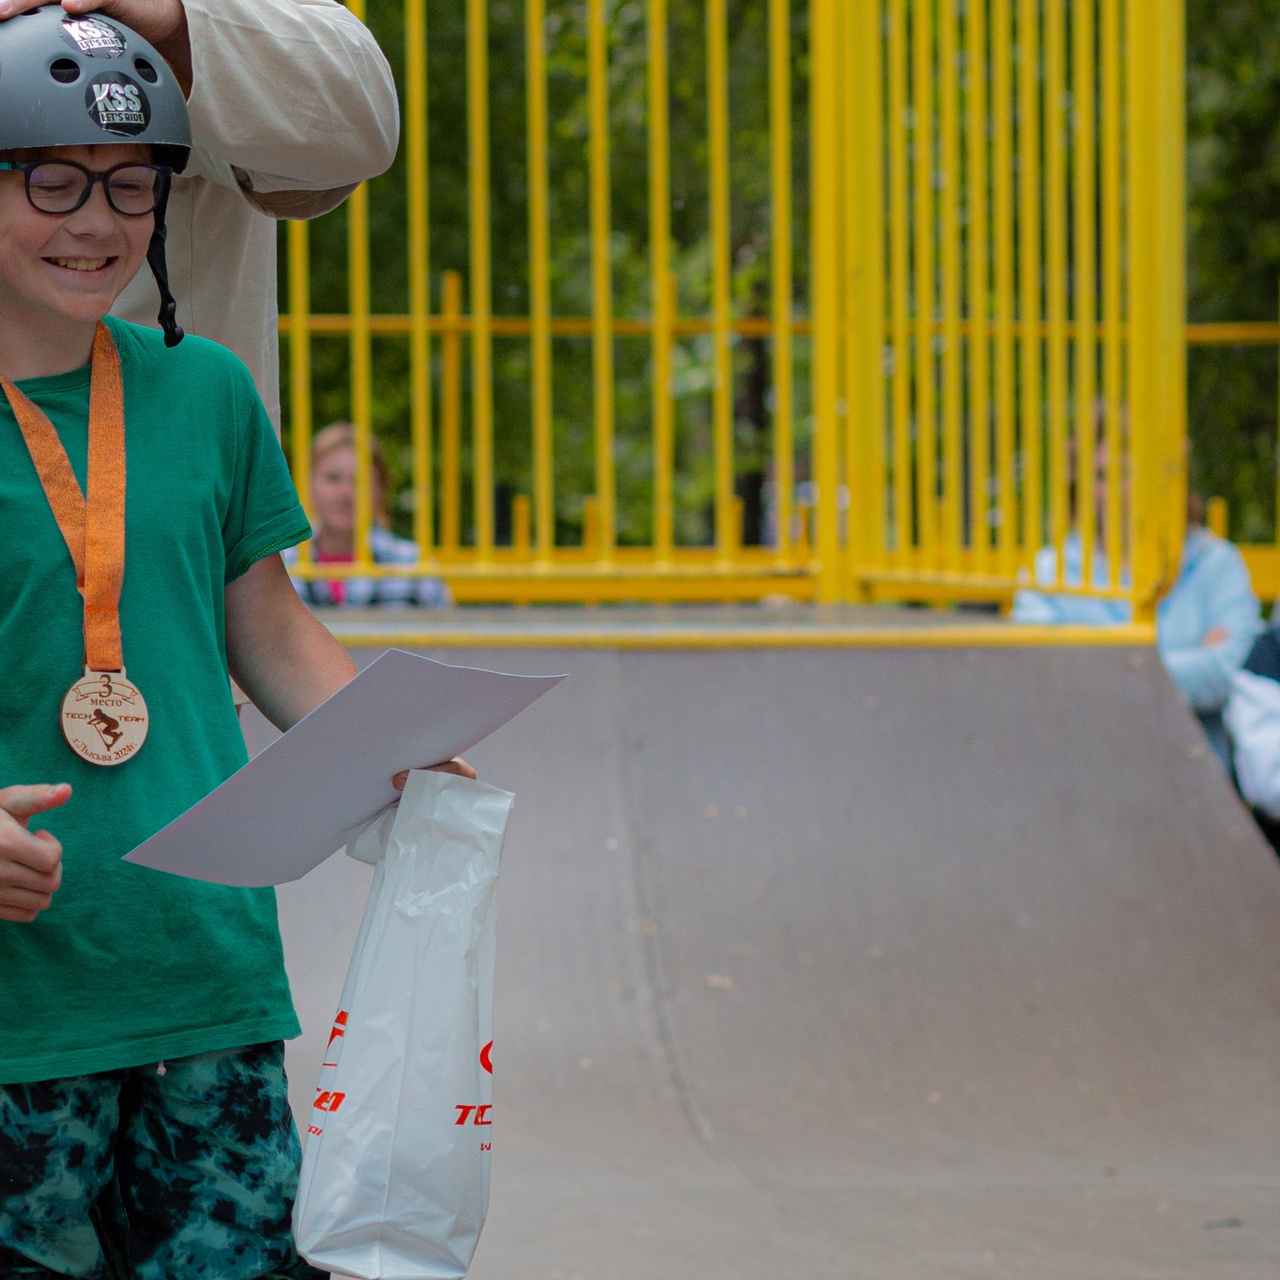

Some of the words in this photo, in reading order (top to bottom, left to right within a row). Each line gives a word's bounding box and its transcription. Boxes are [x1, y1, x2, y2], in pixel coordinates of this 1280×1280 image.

[62, 18, 116, 41] KSS
[92, 83, 142, 112] KSS
[101, 112, 124, 122] LET'S
[125, 112, 144, 122] RIDE
[98, 674, 113, 698] 3
[90, 698, 123, 707] место
[65, 712, 92, 720] TECH
[118, 715, 145, 723] TEAM
